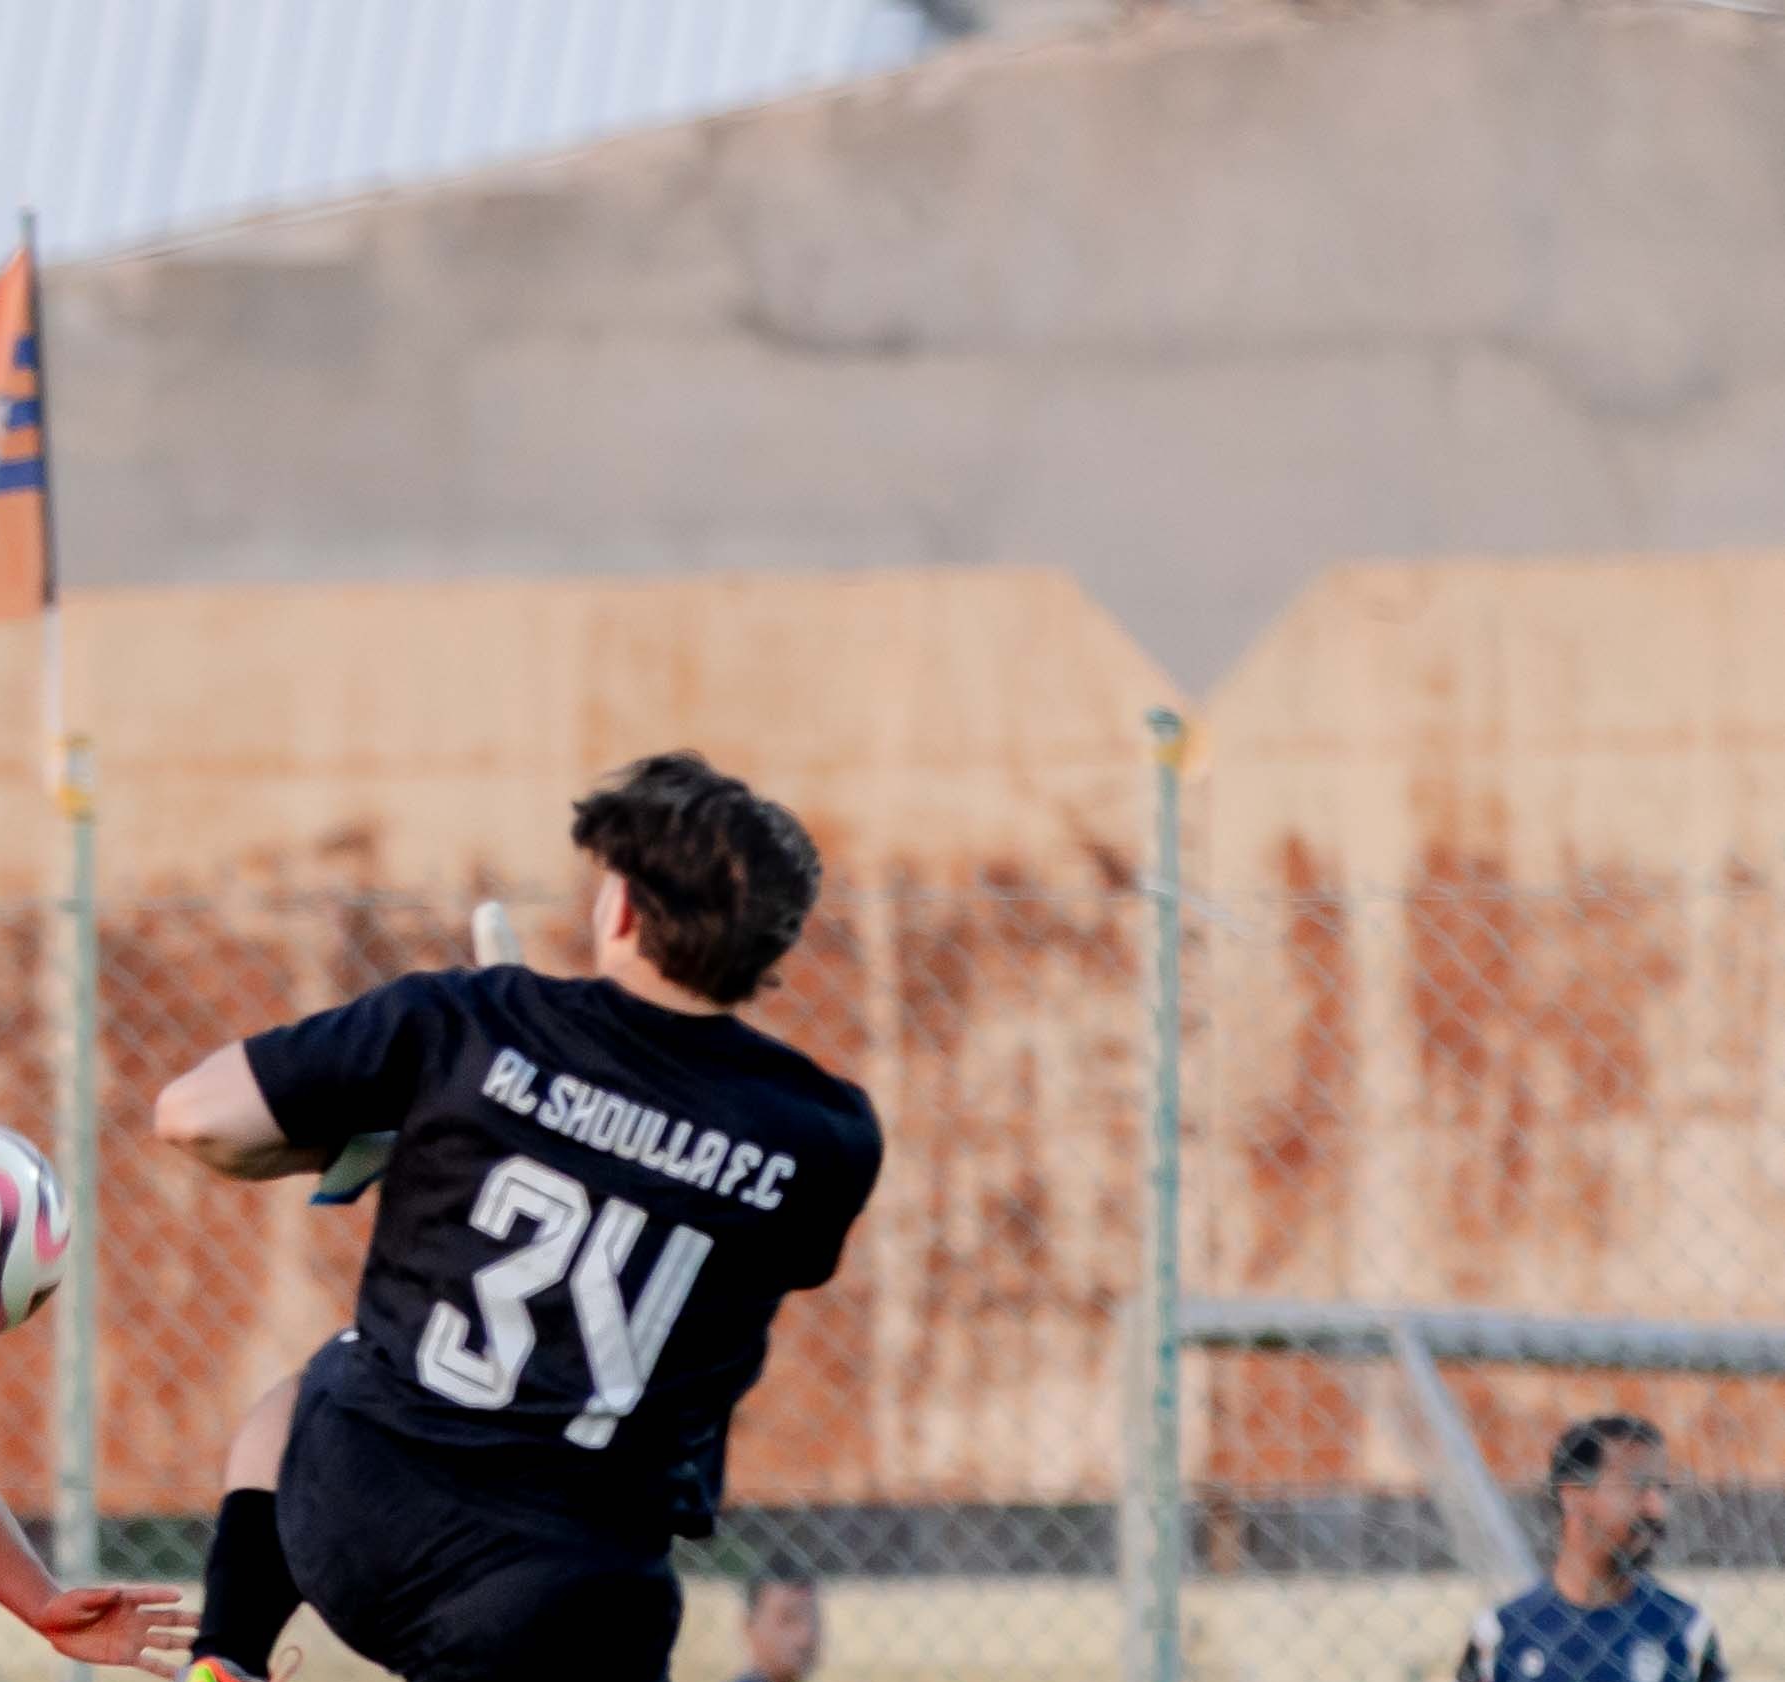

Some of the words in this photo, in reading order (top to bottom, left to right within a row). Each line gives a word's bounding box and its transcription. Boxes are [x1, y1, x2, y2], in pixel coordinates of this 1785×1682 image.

[481, 1048, 538, 1115] AL
[537, 1074, 730, 1190] SHOULLA
[415, 1153, 715, 1450] 34
